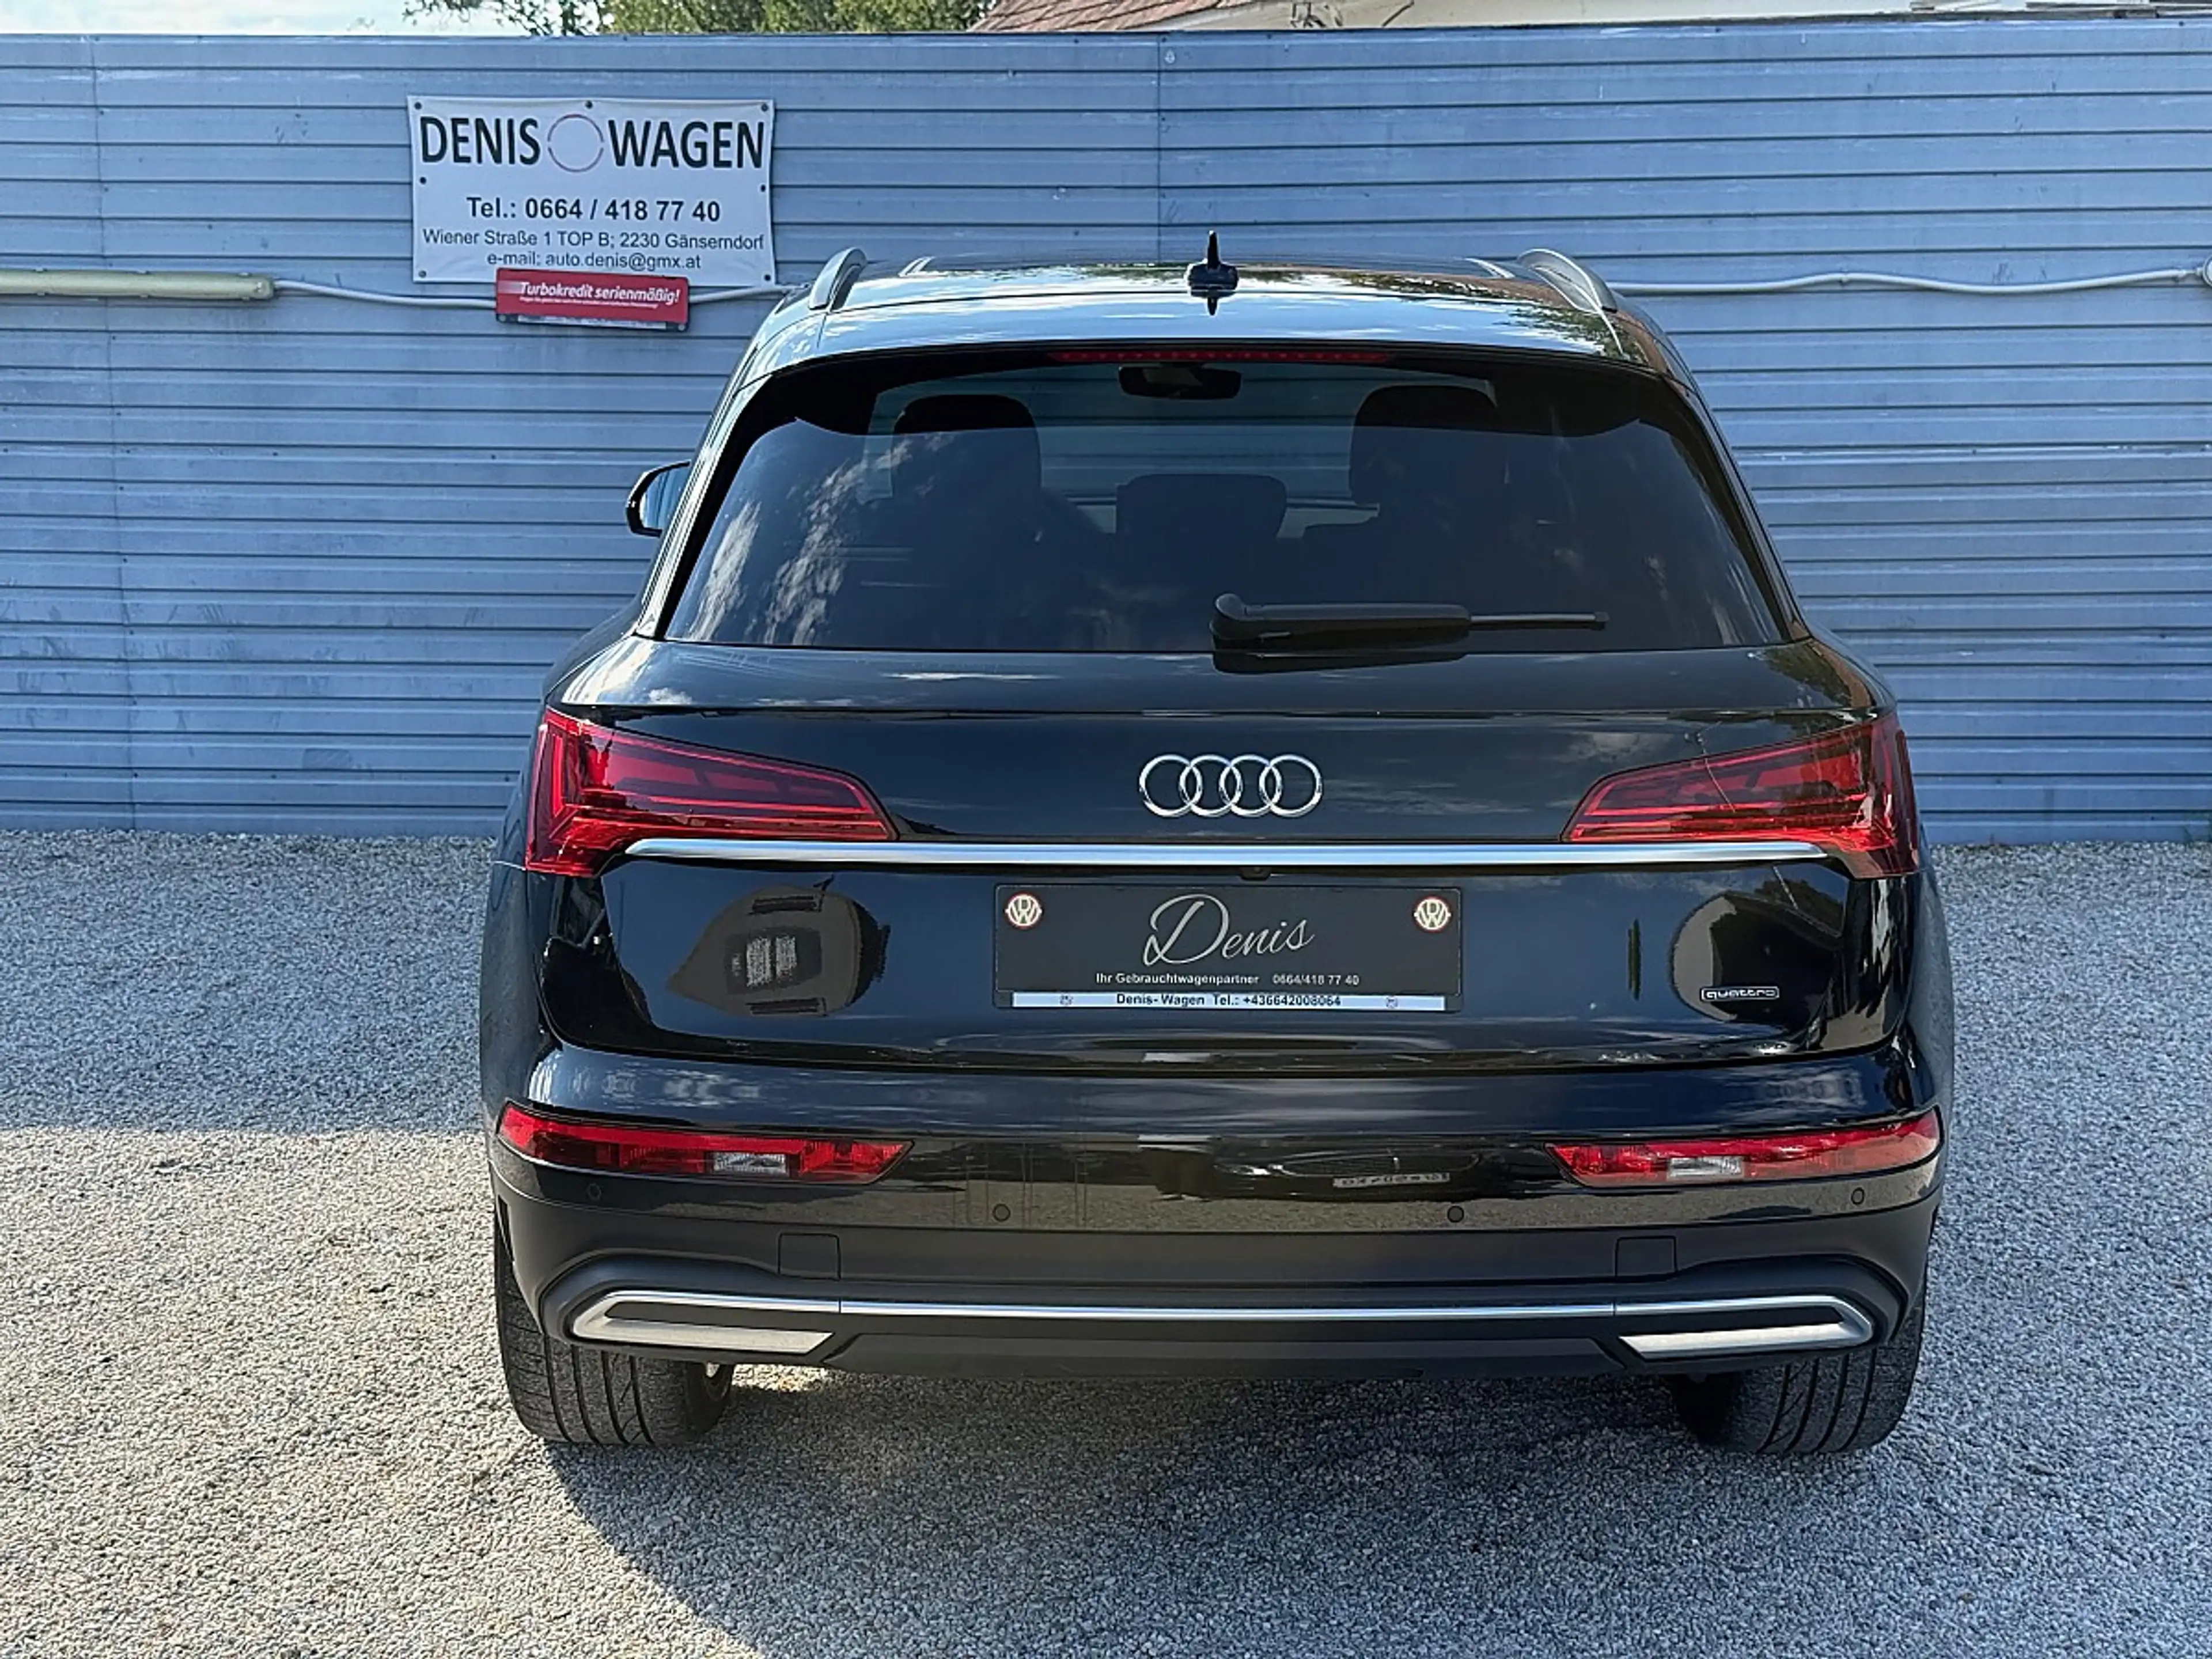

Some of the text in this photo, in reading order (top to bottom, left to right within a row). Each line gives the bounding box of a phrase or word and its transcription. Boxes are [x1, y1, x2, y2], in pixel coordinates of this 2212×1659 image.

[420, 116, 764, 168] DENIS WAGEN
[466, 196, 721, 222] Tel.: 0664 / 418 77 40
[422, 228, 480, 245] Wiener
[484, 229, 537, 246] Straße
[544, 231, 551, 246] 1
[556, 230, 593, 246] TOP
[619, 232, 660, 248] 2230
[665, 232, 765, 250] Gänserndorf
[545, 250, 702, 271] auto.denis@gmx.at
[520, 281, 593, 298] Turbokredit
[593, 285, 680, 305] serienmäßig!
[1143, 893, 1316, 967] Denis
[1096, 972, 1360, 987] Ihr Gebrauchtwagenpartner 0664/418 77 40
[1213, 993, 1239, 1006] Tel.:
[1243, 994, 1342, 1007] +436642008064
[1706, 988, 1776, 999] quattro
